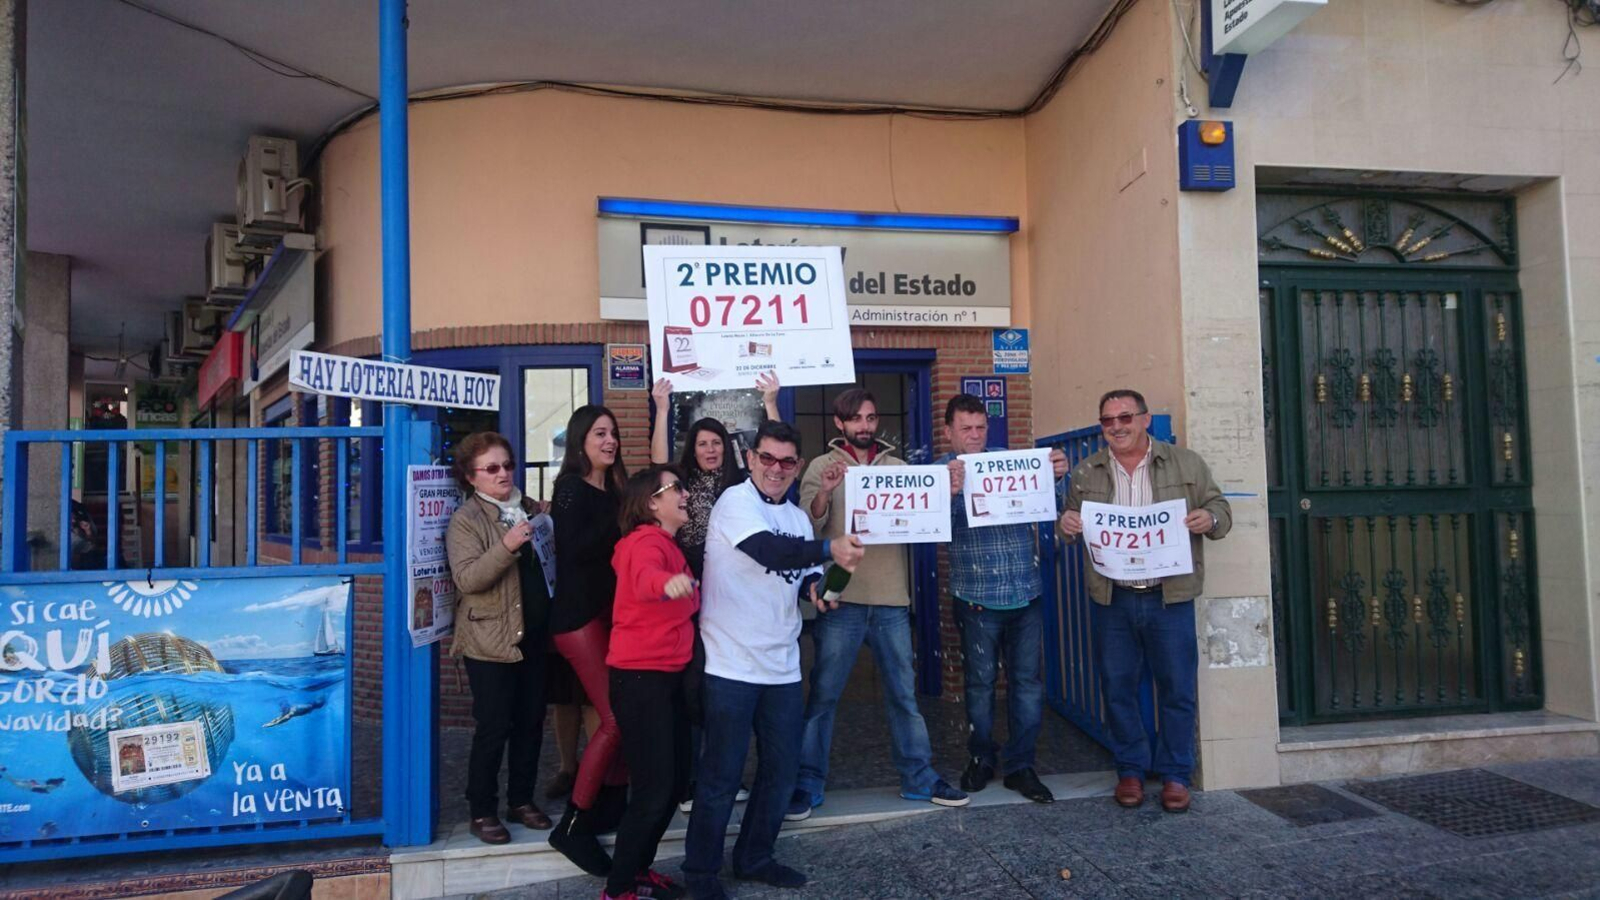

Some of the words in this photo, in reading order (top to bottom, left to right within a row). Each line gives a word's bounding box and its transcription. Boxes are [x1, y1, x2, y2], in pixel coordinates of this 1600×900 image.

[1224, 0, 1253, 21] Apuest
[1224, 11, 1248, 34] Estado
[705, 262, 817, 286] PREMIO
[849, 271, 885, 294] del
[893, 273, 976, 296] Estado
[690, 294, 808, 327] 07211
[852, 308, 948, 322] Administración
[954, 311, 967, 322] nº
[972, 311, 977, 322] 1
[674, 337, 692, 353] 22
[300, 355, 336, 391] HAY
[340, 361, 415, 400] LOTERIA
[420, 371, 459, 403] PARA
[463, 376, 496, 407] HOY
[137, 410, 178, 423] fincas
[988, 457, 1041, 473] PREMIO
[413, 469, 431, 481] DAMOS
[431, 468, 444, 480] OTRO
[876, 475, 935, 489] PREMIO
[982, 474, 1038, 493] 07211
[419, 489, 436, 499] GRAN
[436, 488, 457, 498] PREMIO
[866, 492, 929, 510] 07211
[1109, 511, 1170, 529] PREMIO
[1100, 528, 1165, 549] 07211
[419, 546, 442, 556] VENDIDO
[413, 566, 436, 577] Lotería
[434, 580, 453, 594] 0721
[43, 599, 97, 622] cae
[0, 619, 111, 675] QUÍ
[144, 733, 180, 745] 29192
[232, 761, 263, 785] Ya
[270, 763, 287, 780] a
[232, 791, 257, 817] la
